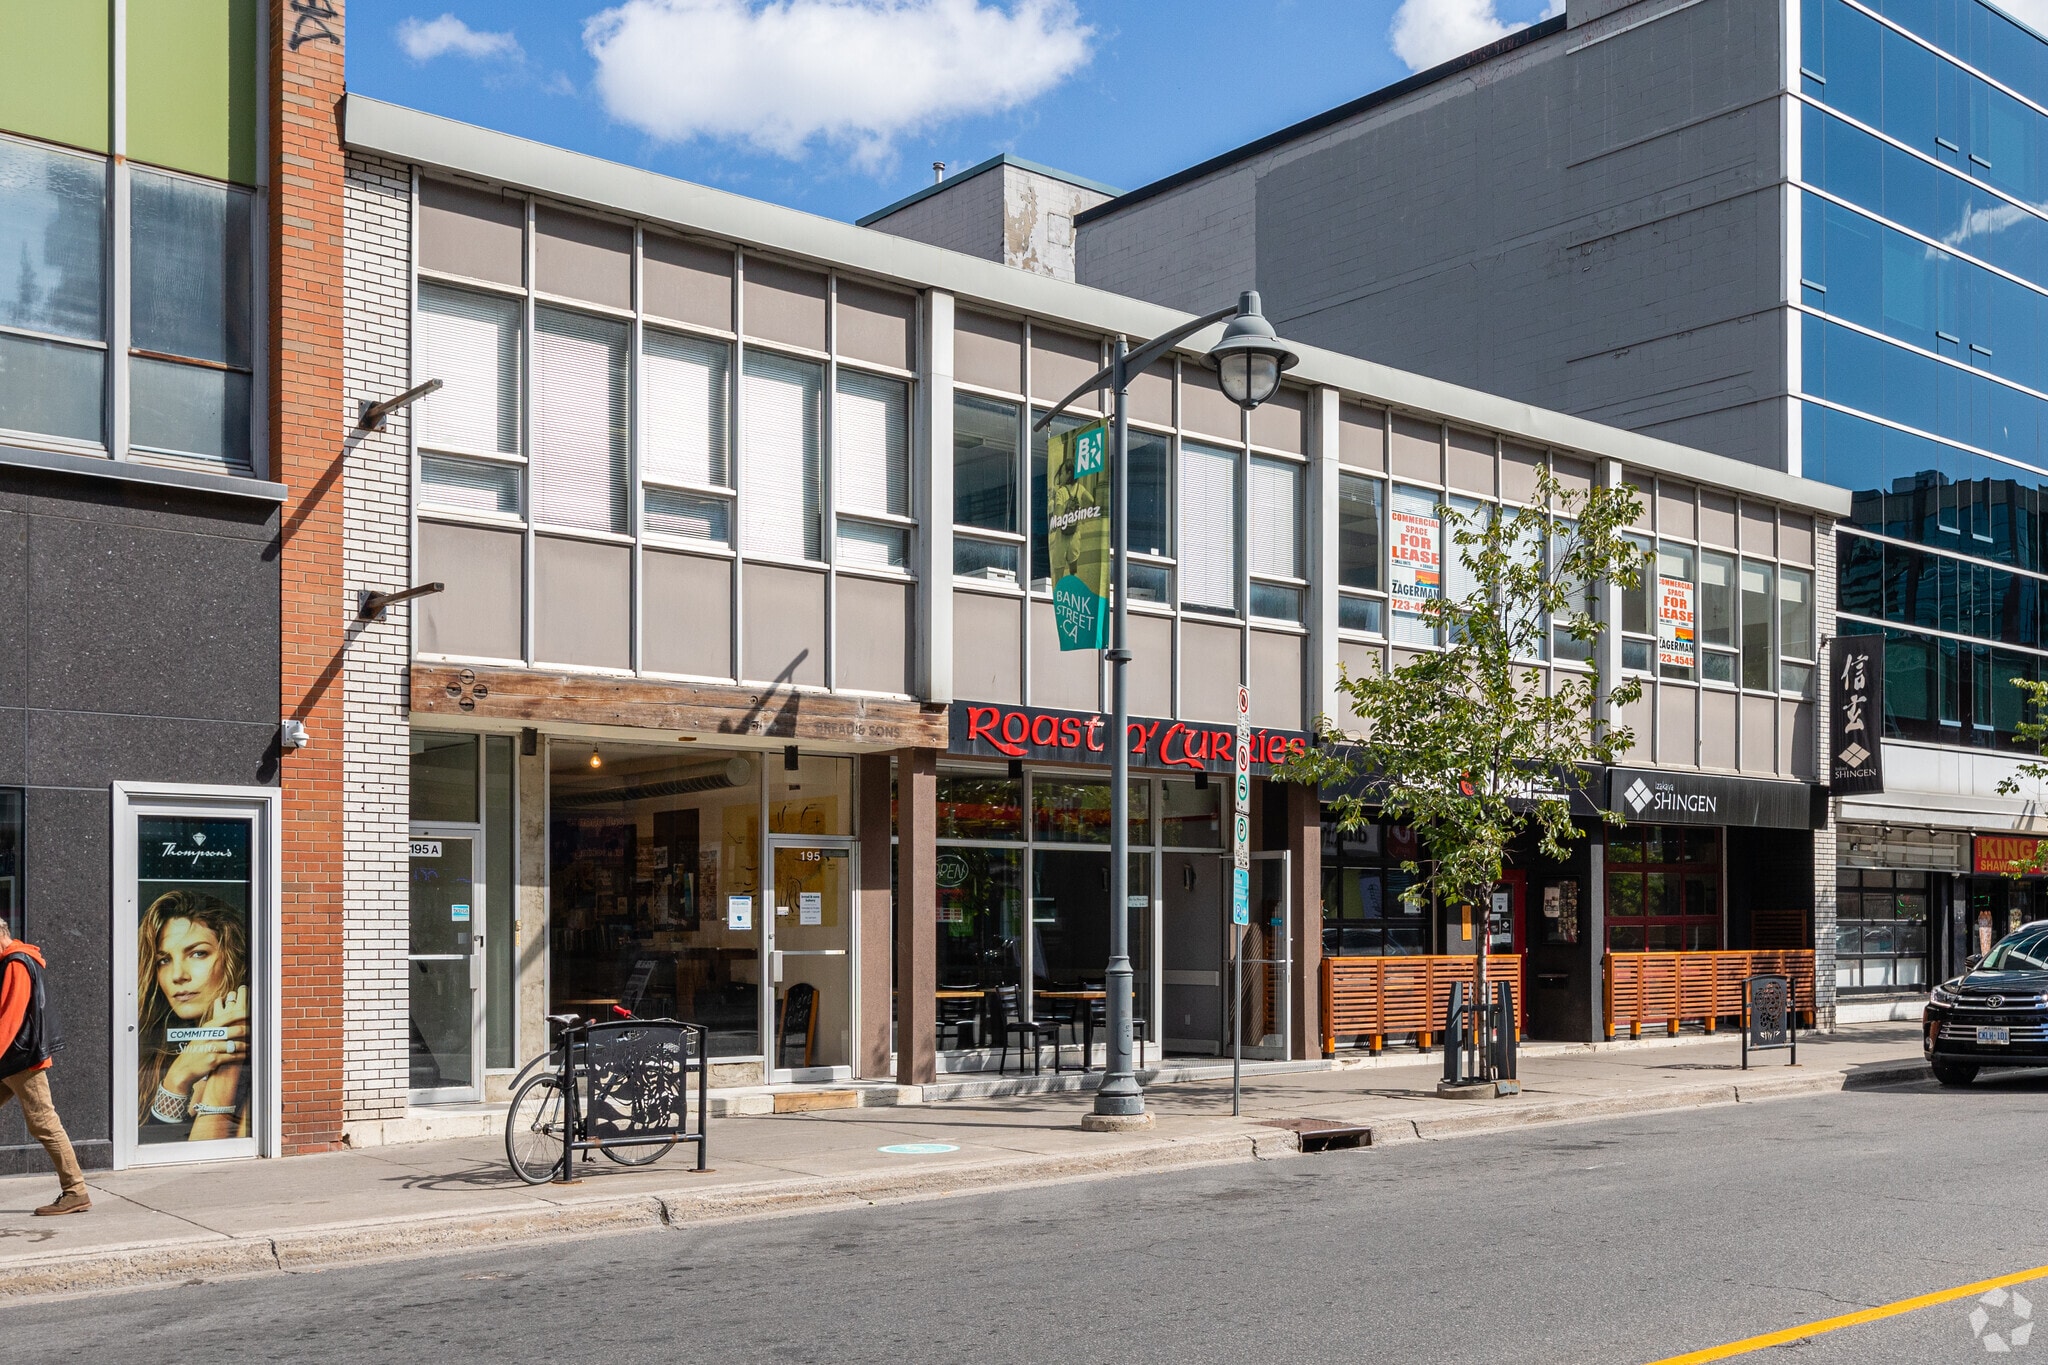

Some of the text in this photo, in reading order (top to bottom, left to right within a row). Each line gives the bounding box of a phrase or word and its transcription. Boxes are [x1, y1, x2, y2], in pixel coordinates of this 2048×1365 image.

[1050, 506, 1101, 530] Magasinez
[1391, 512, 1439, 528] COMMERCIAL
[1405, 525, 1428, 536] SPACE
[1400, 533, 1431, 550] FOR
[1391, 545, 1440, 565] LEASE
[1391, 582, 1440, 600] ZAGERMAN
[1667, 588, 1685, 598] SPACE
[1056, 590, 1091, 615] BANK
[1391, 599, 1440, 615] 723-4
[1663, 595, 1687, 610] FOR
[1056, 605, 1095, 631] STREET
[1841, 653, 1869, 734] 信玄
[868, 725, 901, 738] SONS
[967, 706, 1105, 757] Roast
[1834, 768, 1877, 780] SHINGEN
[1654, 792, 1717, 813] SHINGEN
[161, 842, 233, 865] Thompson's
[410, 843, 439, 854] 195 A
[800, 851, 821, 861] 195
[1981, 838, 2033, 860] KING
[169, 1029, 225, 1039] COMMITTED
